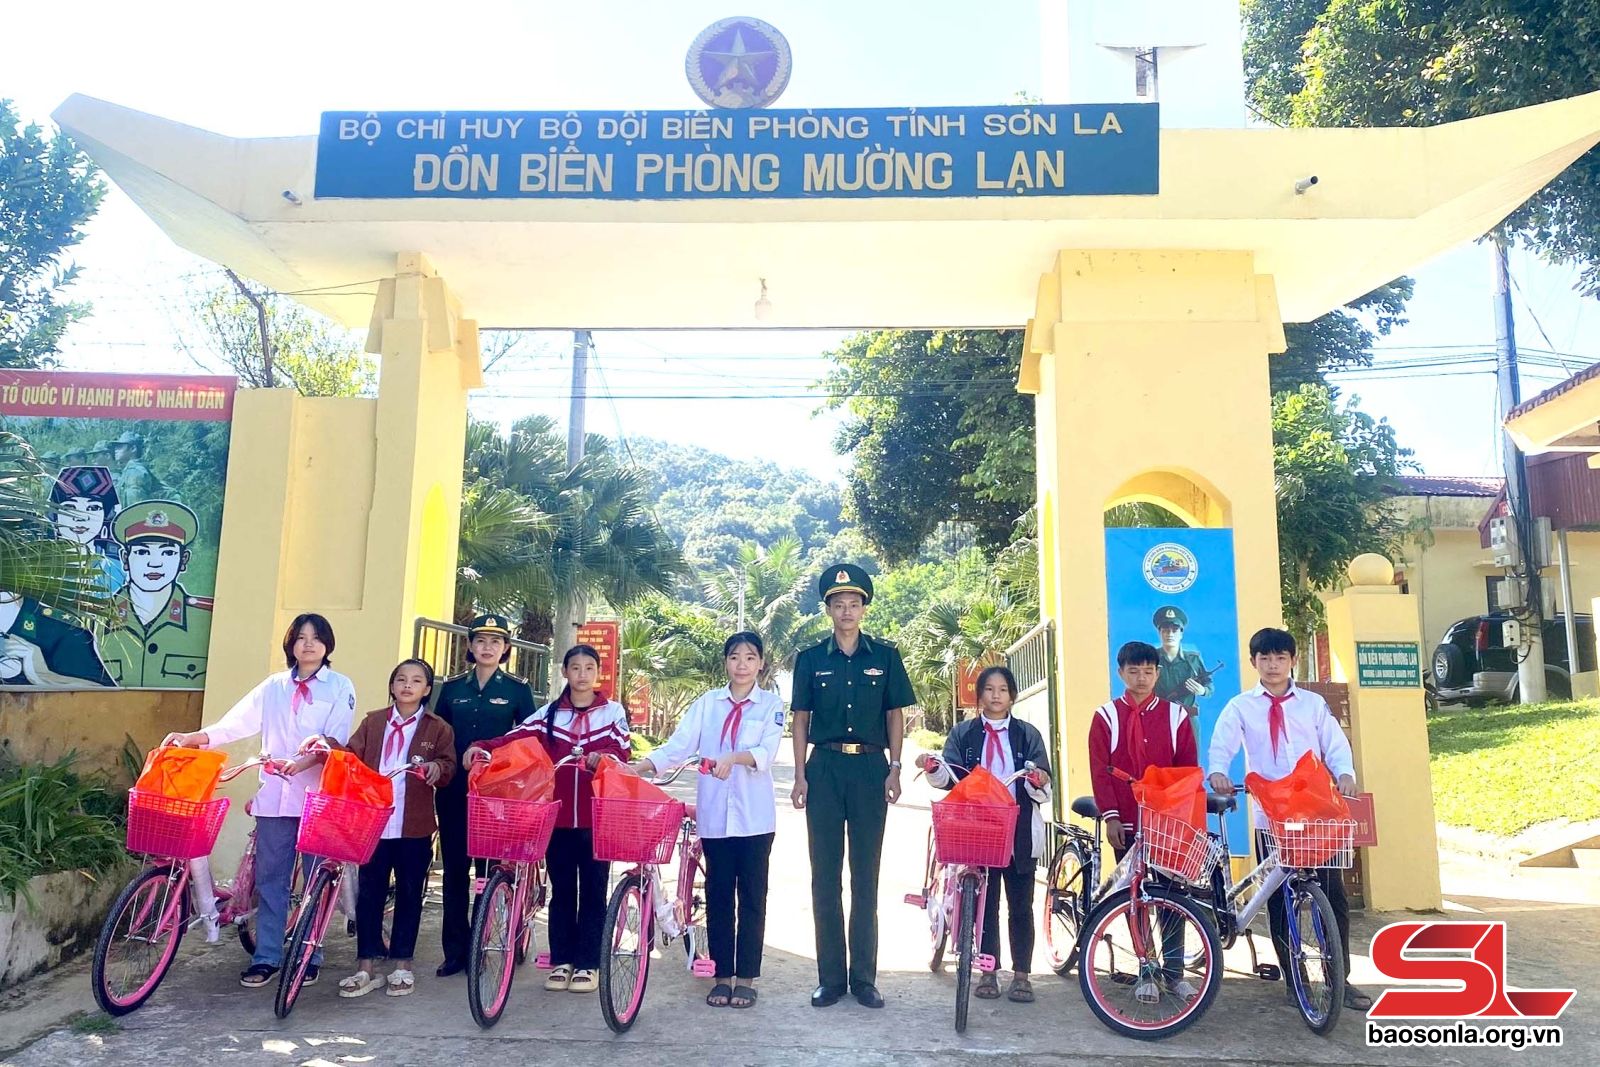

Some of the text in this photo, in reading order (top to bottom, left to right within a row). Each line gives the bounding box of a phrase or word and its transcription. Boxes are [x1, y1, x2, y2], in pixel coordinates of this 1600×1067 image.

[339, 107, 1124, 146] BỘ CHỈ HUY BỘ ĐỘI BIÊN PHÒNG TỈNH SƠN LA
[413, 143, 1064, 194] ĐỒN BIÊN PHÒNG MƯỜNG LẠN
[21, 379, 58, 406] QUỐC
[61, 384, 74, 406] VÌ
[77, 387, 114, 410] HẠNH
[156, 386, 193, 409] NHÂN
